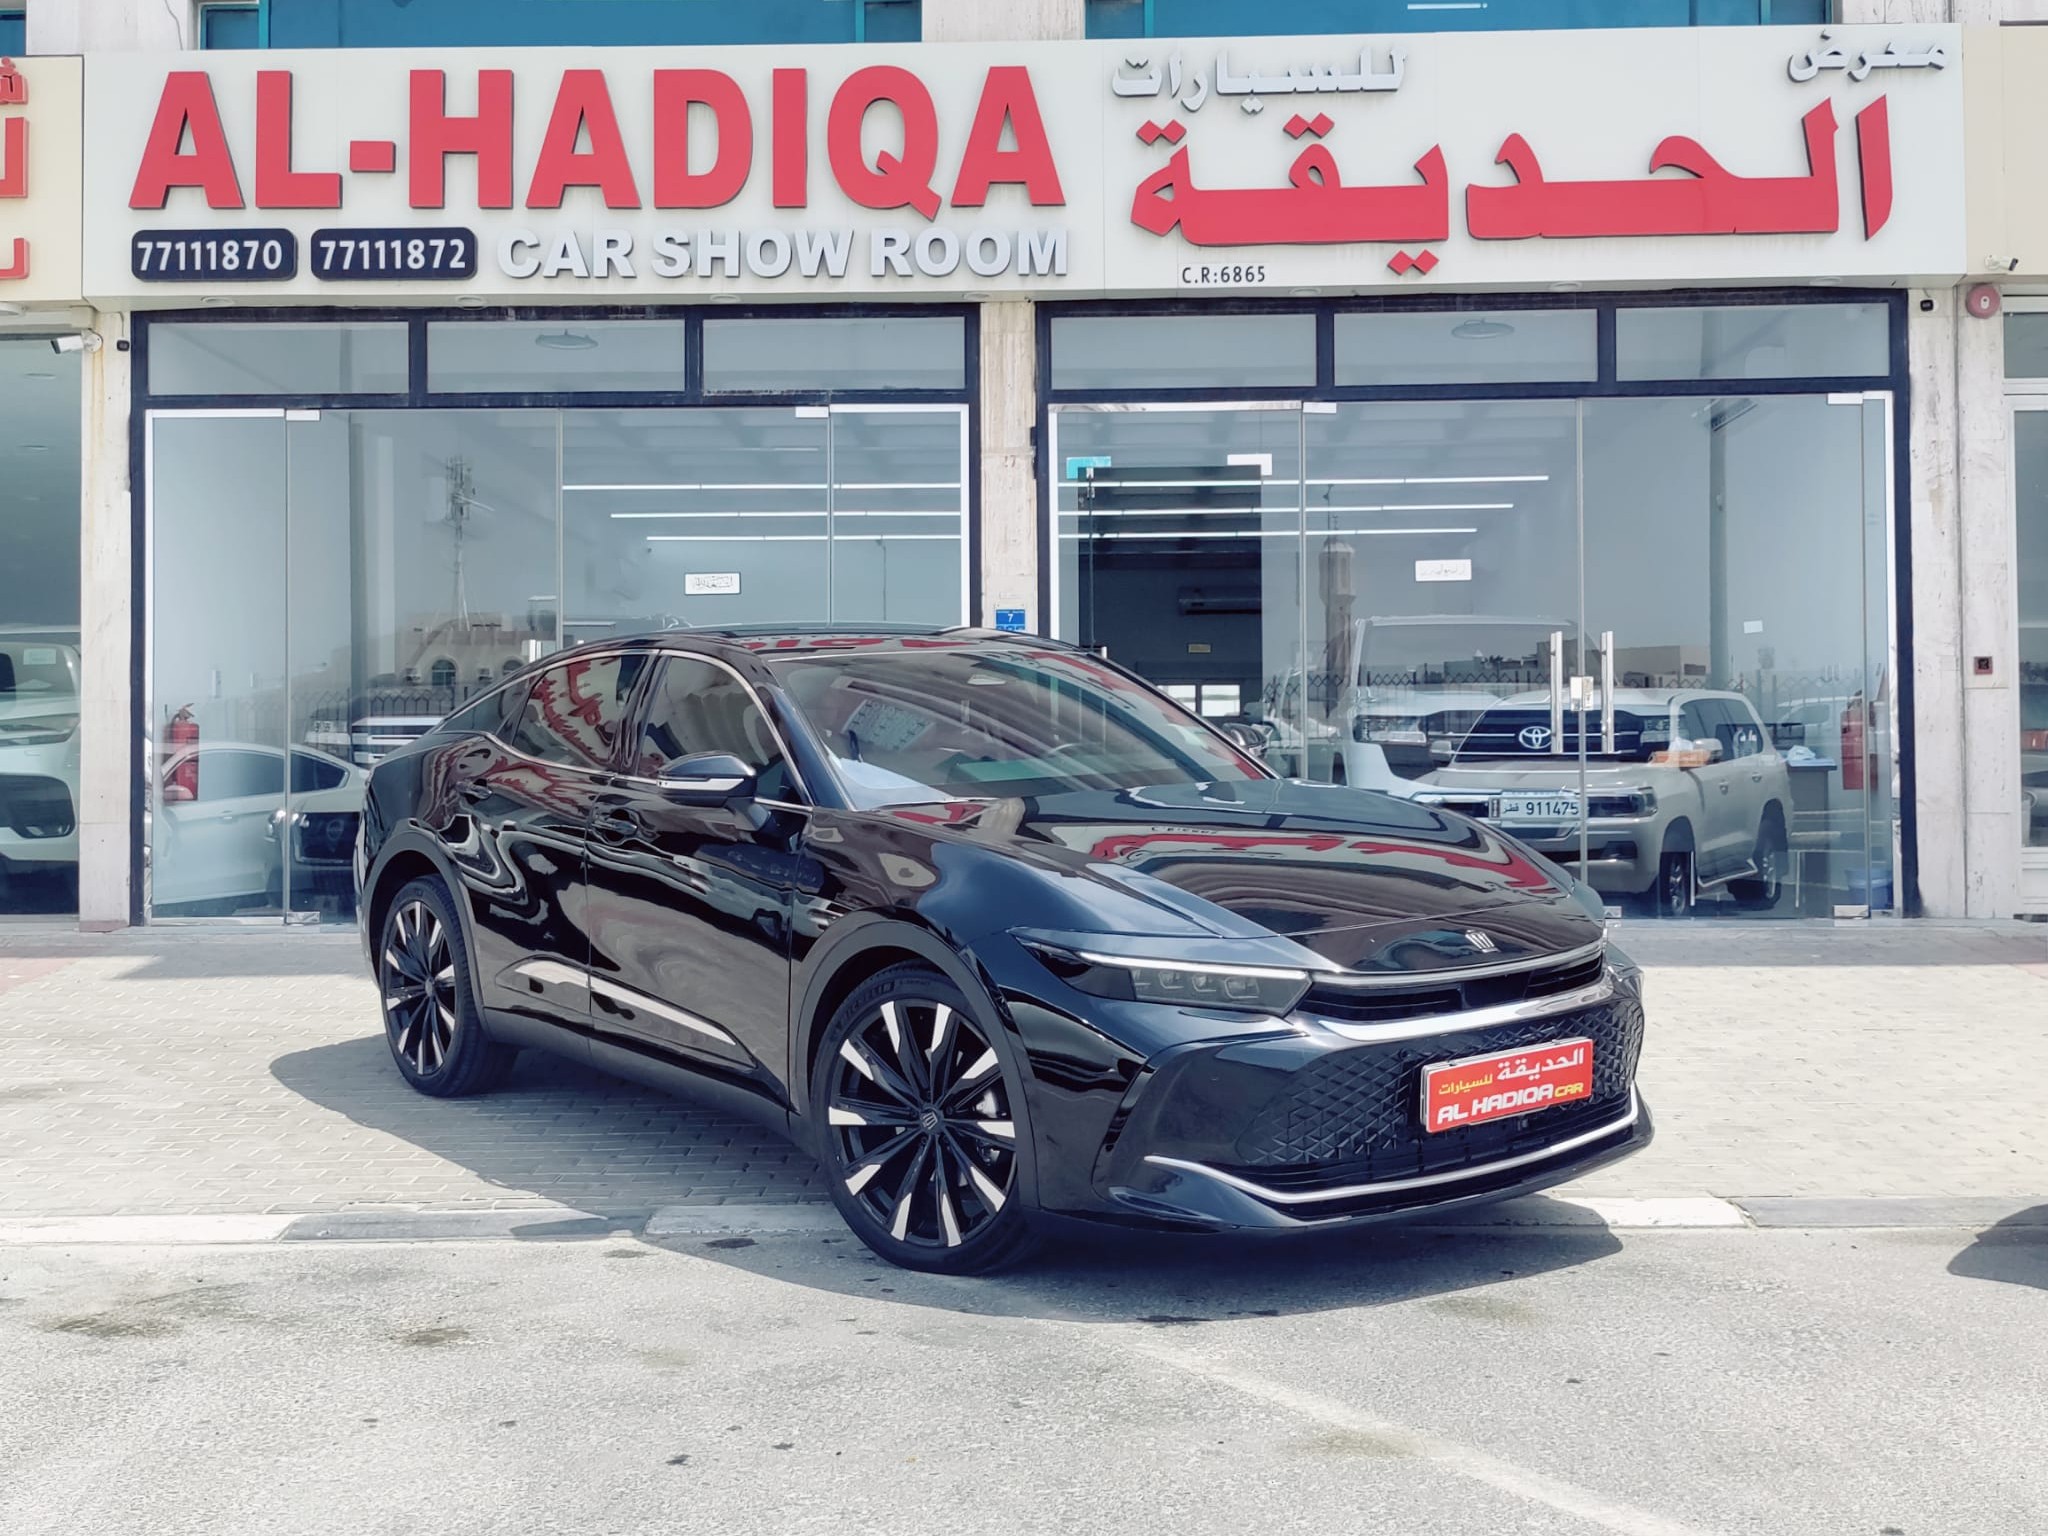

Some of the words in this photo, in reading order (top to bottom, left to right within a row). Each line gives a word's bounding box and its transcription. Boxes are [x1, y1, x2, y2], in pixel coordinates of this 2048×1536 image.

[1787, 28, 1946, 83] معرض
[1111, 46, 1407, 113] للسيارات
[128, 64, 1067, 222] AL-HADIQA
[1130, 93, 1894, 276] الحديقة
[137, 239, 283, 272] 77111870
[319, 238, 467, 271] 77111872
[496, 228, 637, 279] CAR
[650, 227, 854, 278] SHOW
[870, 226, 1069, 277] ROOM
[1182, 265, 1265, 284] C.R:6865
[1007, 613, 1014, 623] 7
[1525, 801, 1580, 816] 911475
[1497, 1048, 1585, 1081] الحديقة
[1438, 1073, 1493, 1096] للسيارات
[1437, 1103, 1469, 1125] AL
[1554, 1082, 1584, 1098] CAR
